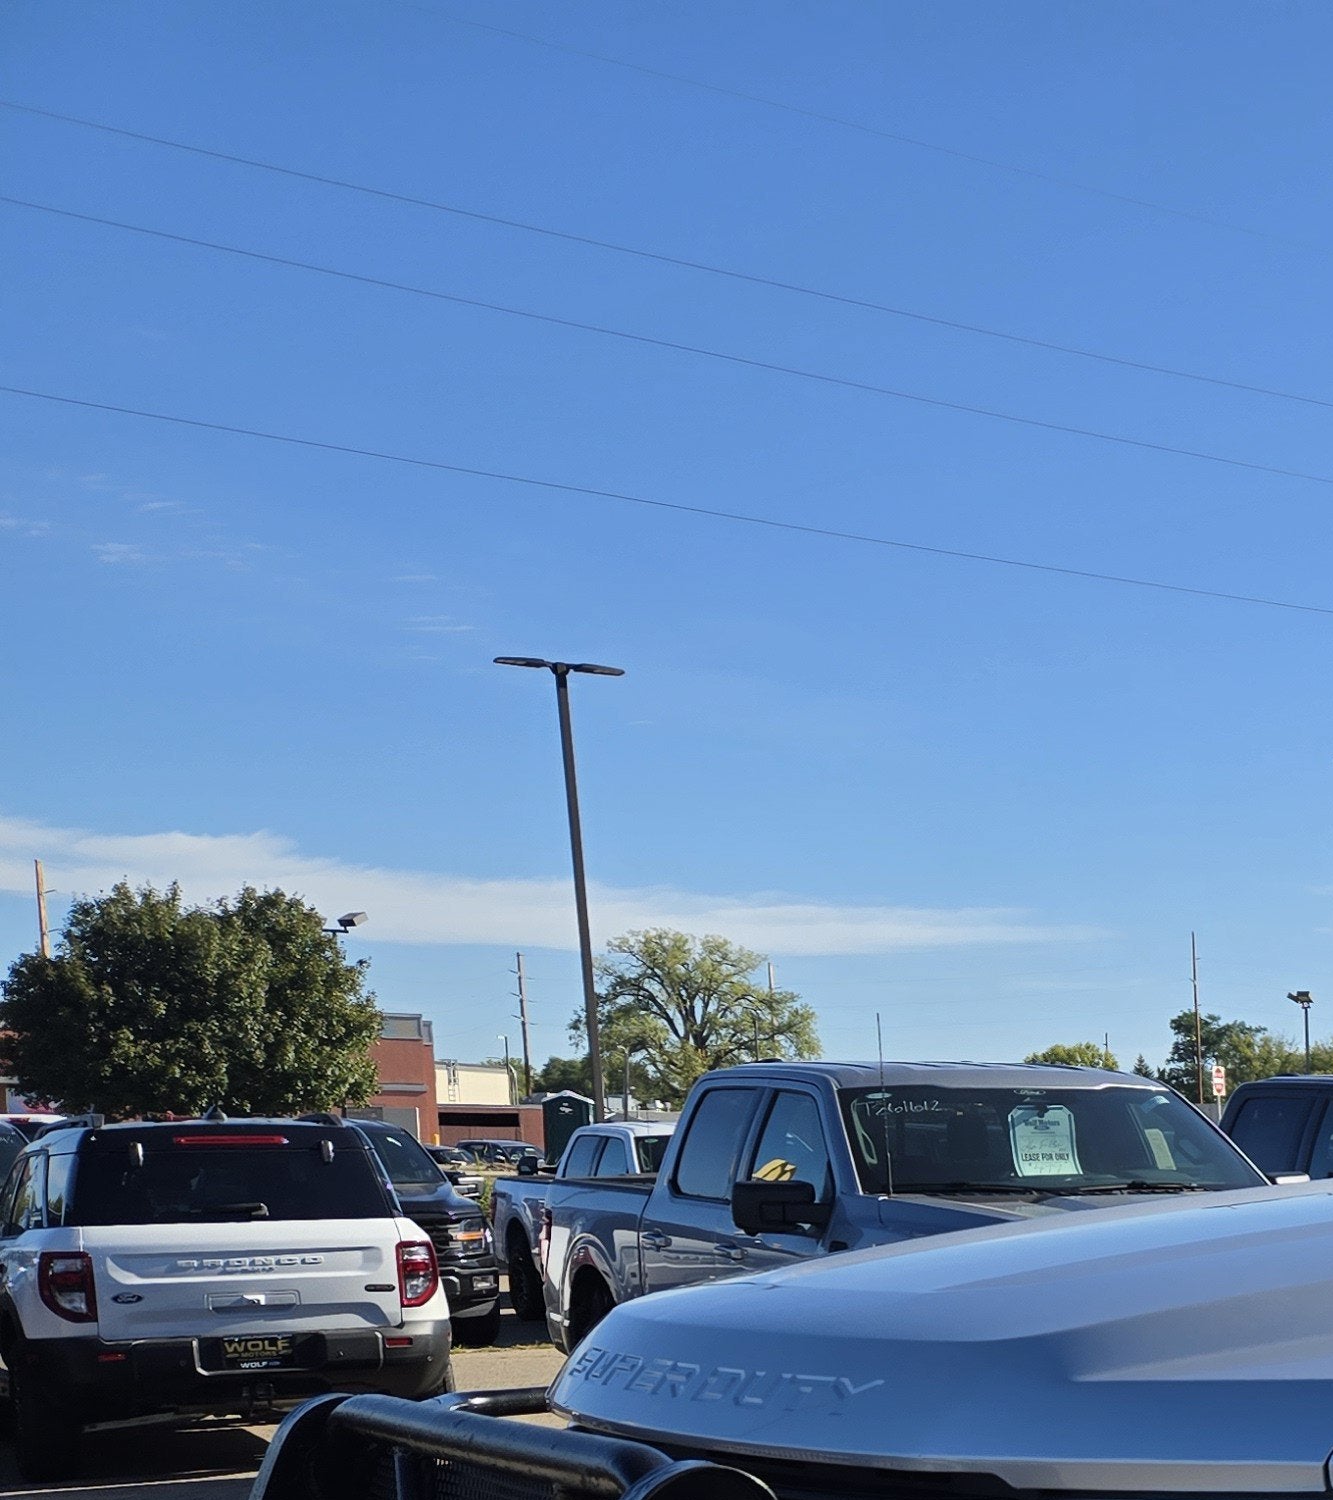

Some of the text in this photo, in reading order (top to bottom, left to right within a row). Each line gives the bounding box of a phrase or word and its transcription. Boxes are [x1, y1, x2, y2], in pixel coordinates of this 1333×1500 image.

[1021, 1153, 1040, 1161] LEASE
[1055, 1152, 1069, 1160] ONLY
[176, 1255, 325, 1268] BRONCO
[224, 1339, 290, 1353] WOLF
[569, 1347, 885, 1416] SUPER DUTY
